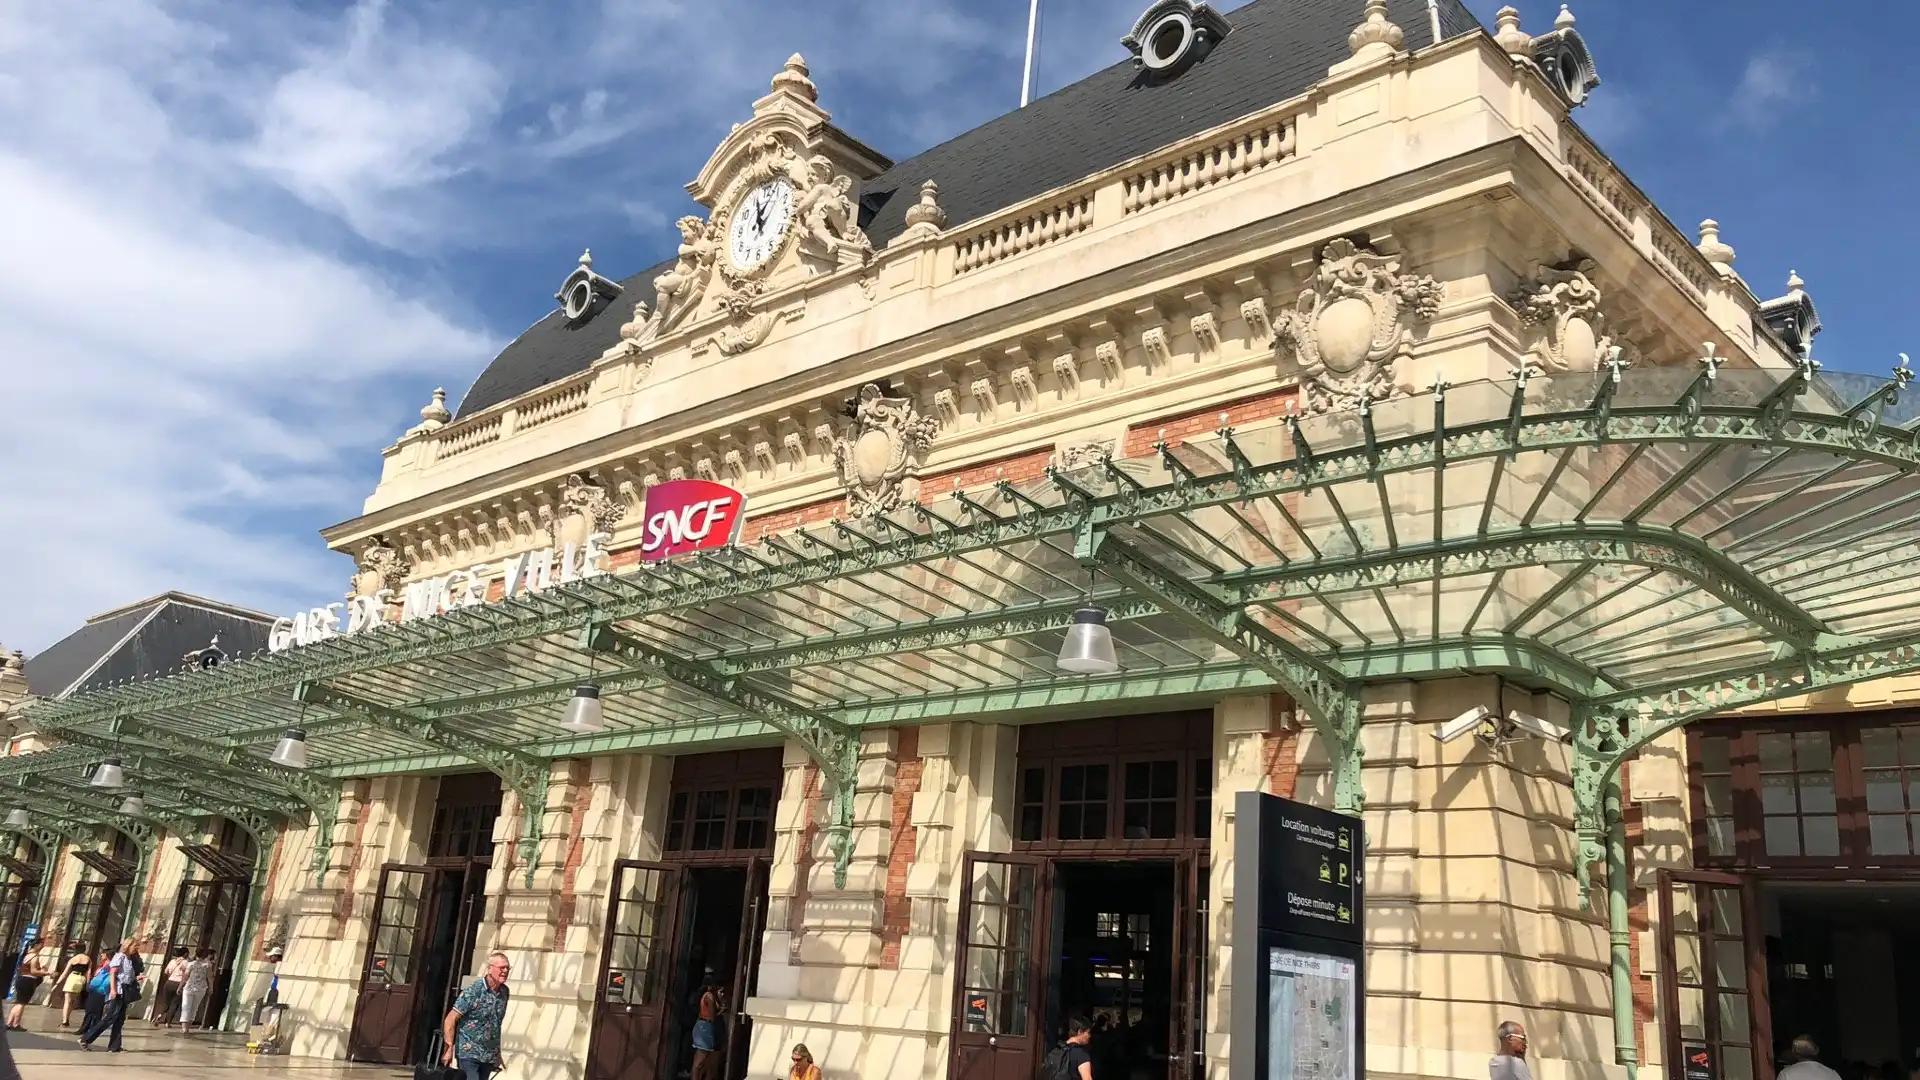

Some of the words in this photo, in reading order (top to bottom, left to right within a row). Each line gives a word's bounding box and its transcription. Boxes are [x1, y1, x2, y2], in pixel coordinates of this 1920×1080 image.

[783, 208, 788, 219] 3
[641, 496, 732, 551] SNCF
[268, 602, 344, 653] GARE
[346, 589, 395, 638] DE
[401, 564, 490, 622] NICE
[504, 532, 612, 598] VILLE
[1281, 815, 1310, 834] Location
[1310, 825, 1336, 840] voitures
[1339, 862, 1348, 883] P
[1287, 891, 1312, 908] Dépose
[1312, 898, 1336, 912] minute
